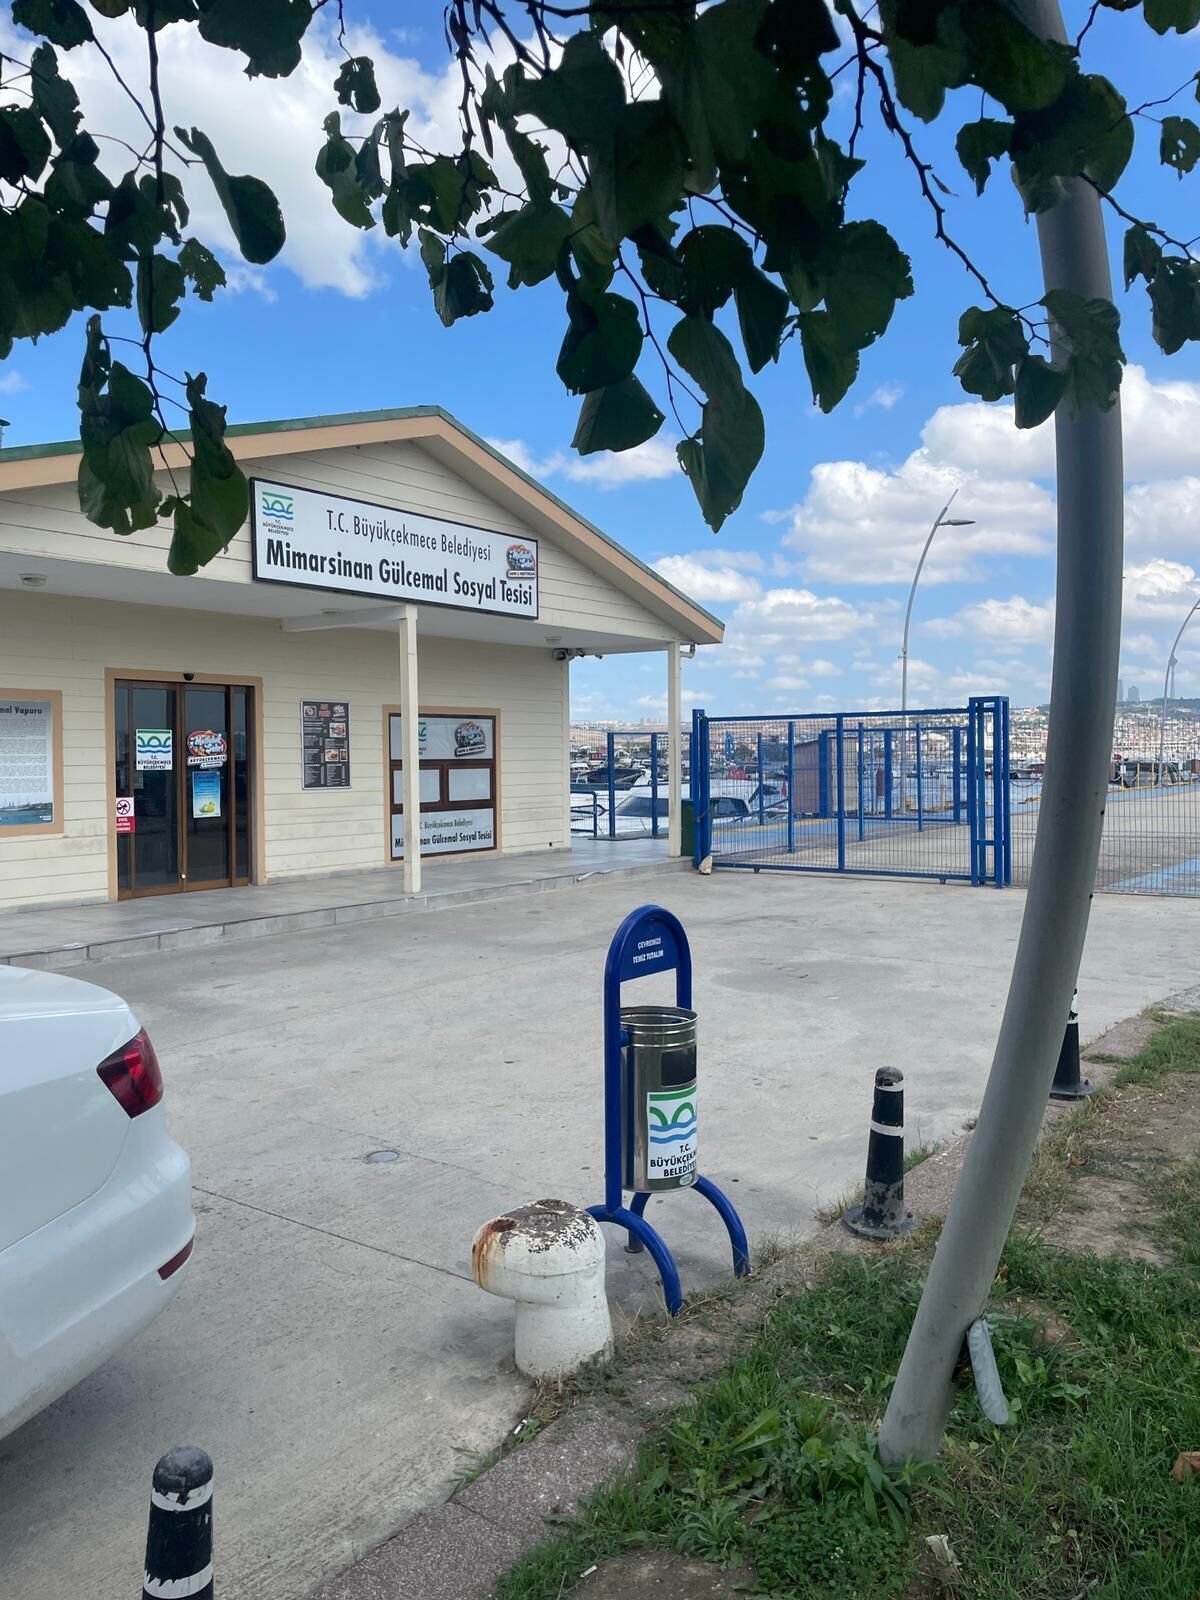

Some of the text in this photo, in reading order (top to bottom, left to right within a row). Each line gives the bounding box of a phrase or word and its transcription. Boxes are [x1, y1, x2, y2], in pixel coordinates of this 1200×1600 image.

[326, 509, 349, 533] T.C.
[353, 516, 437, 550] Büyükçekmece
[441, 534, 491, 562] Belediyesi
[266, 538, 532, 606] Mimarsinan Gülcemal Sosyal Tesisi
[431, 833, 458, 845] Gülcemal
[459, 831, 477, 844] Sosyal
[478, 830, 492, 840] Tesisi
[680, 1143, 691, 1153] T.C.
